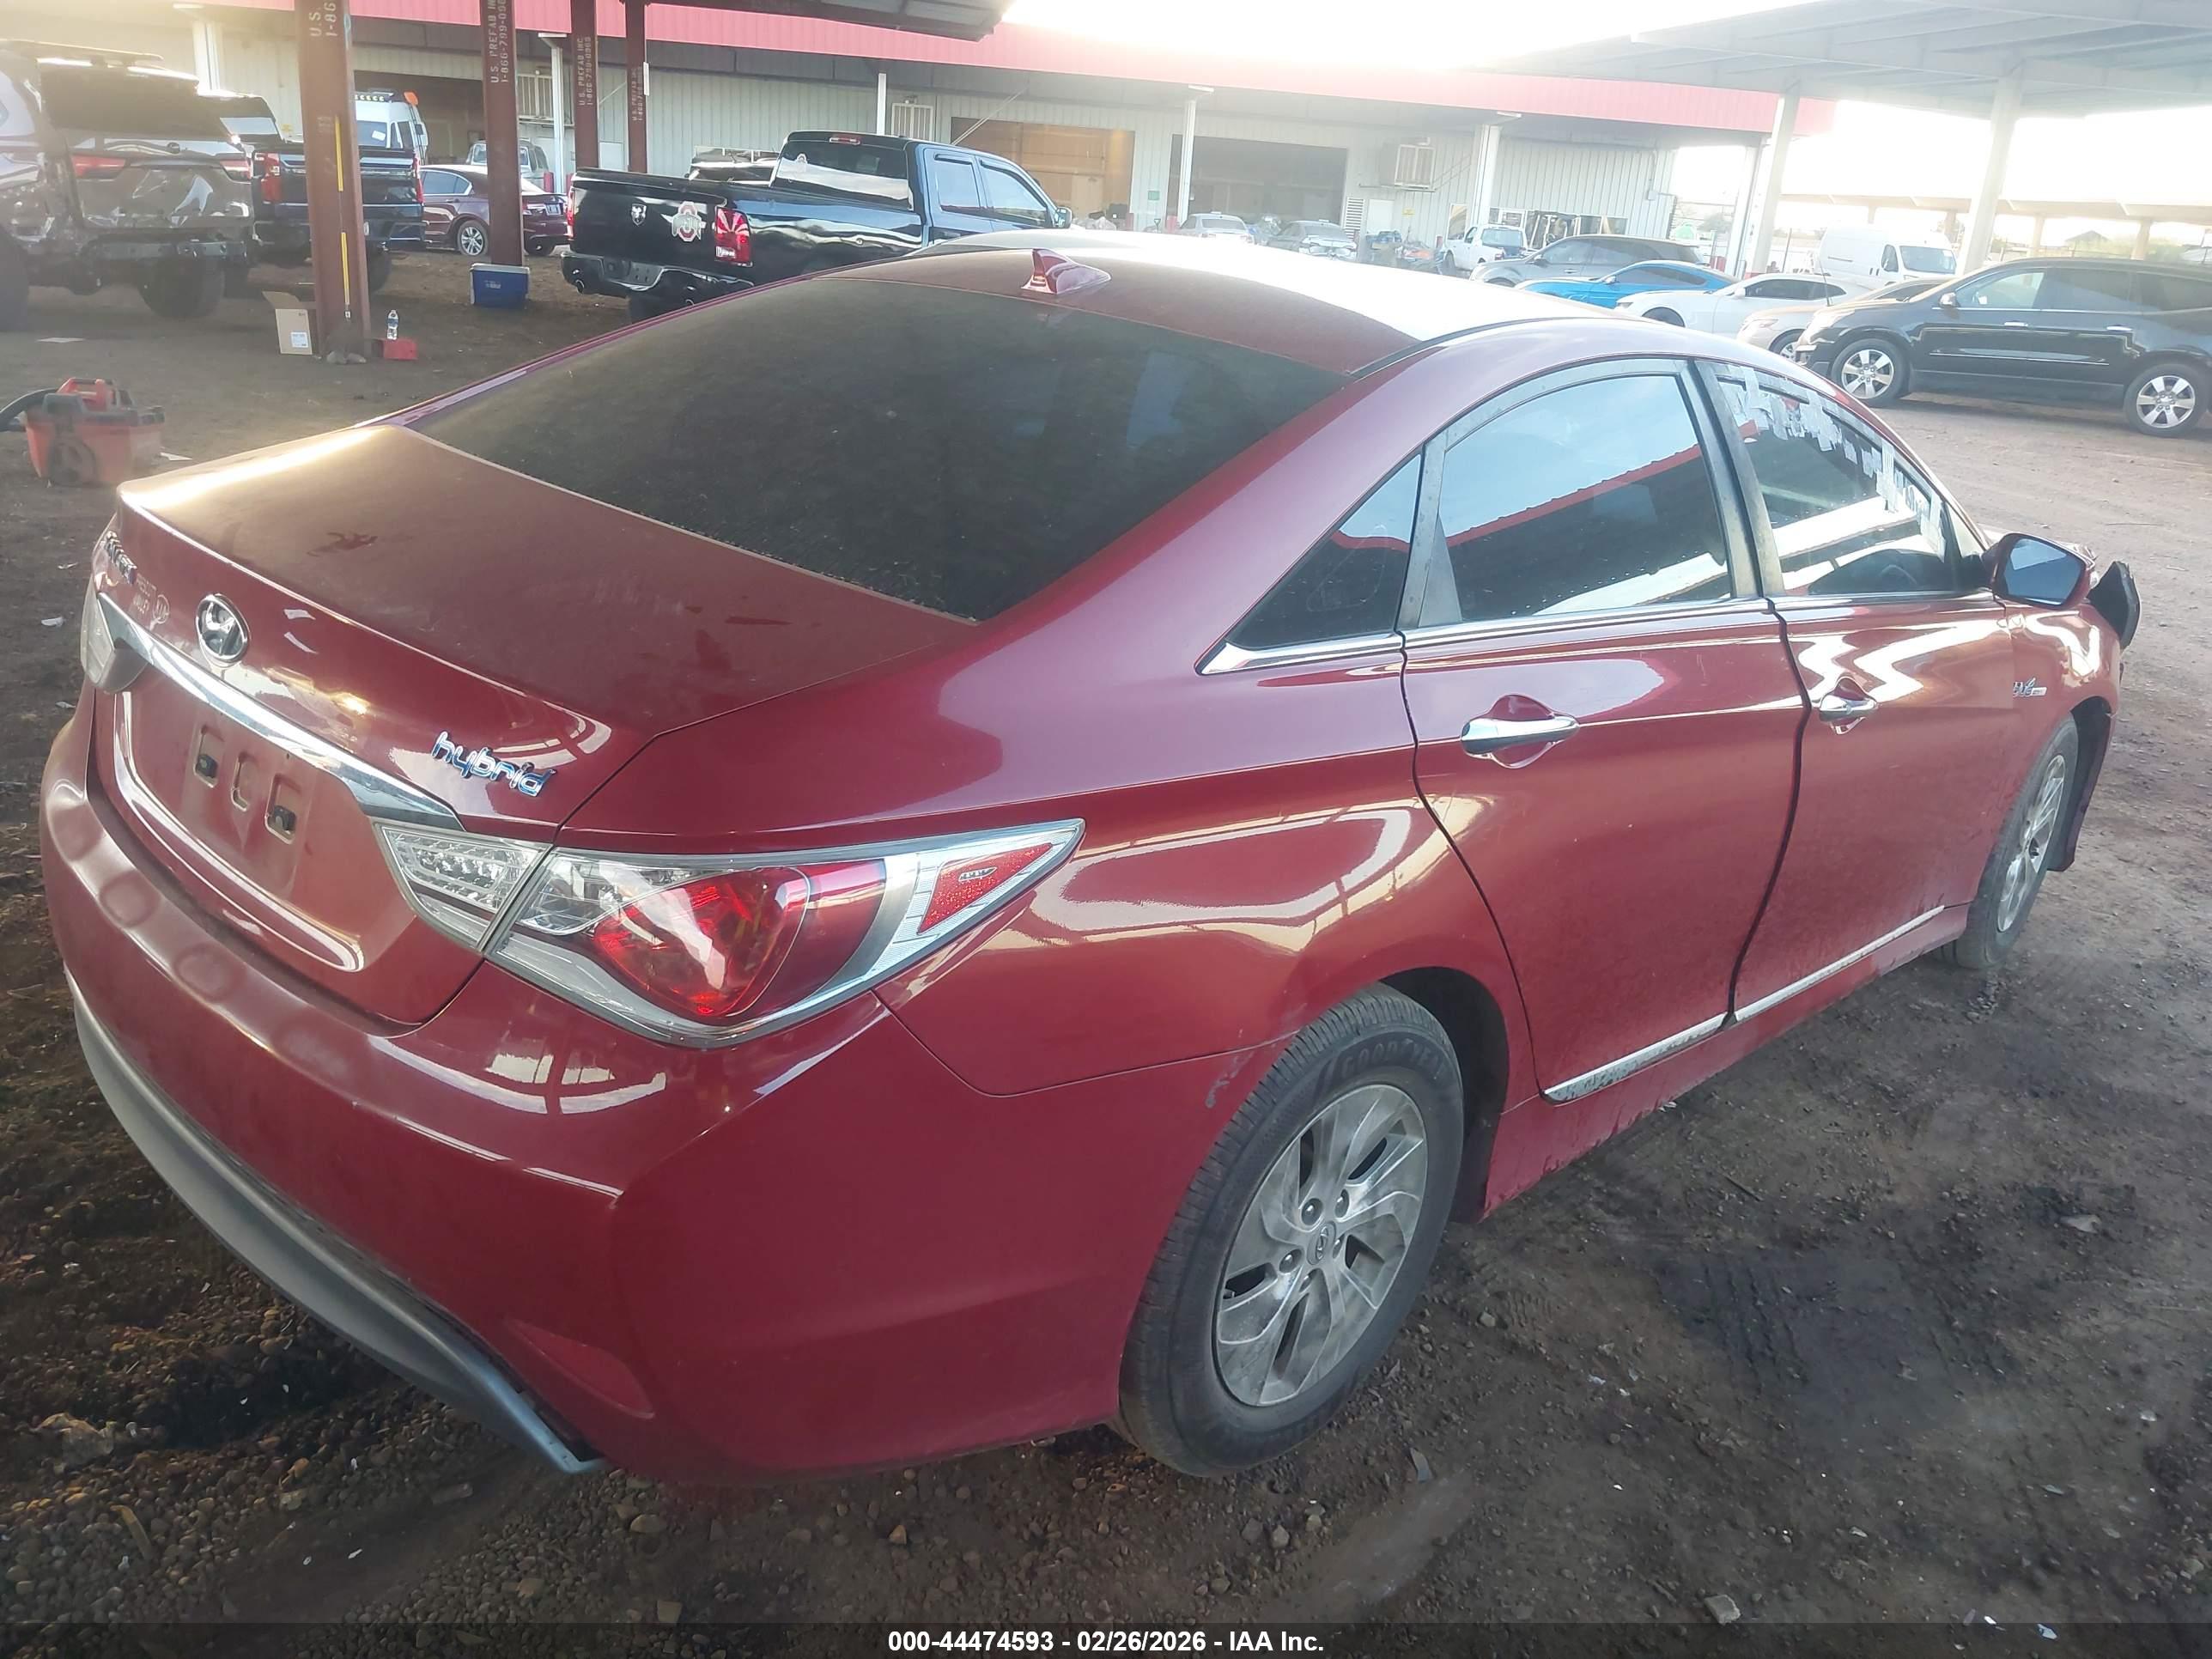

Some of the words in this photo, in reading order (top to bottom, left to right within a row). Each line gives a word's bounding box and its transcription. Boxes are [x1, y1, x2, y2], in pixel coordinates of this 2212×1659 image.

[487, 15, 498, 57] PREFAB
[489, 63, 500, 83] U.S.
[431, 731, 556, 797] hybrid
